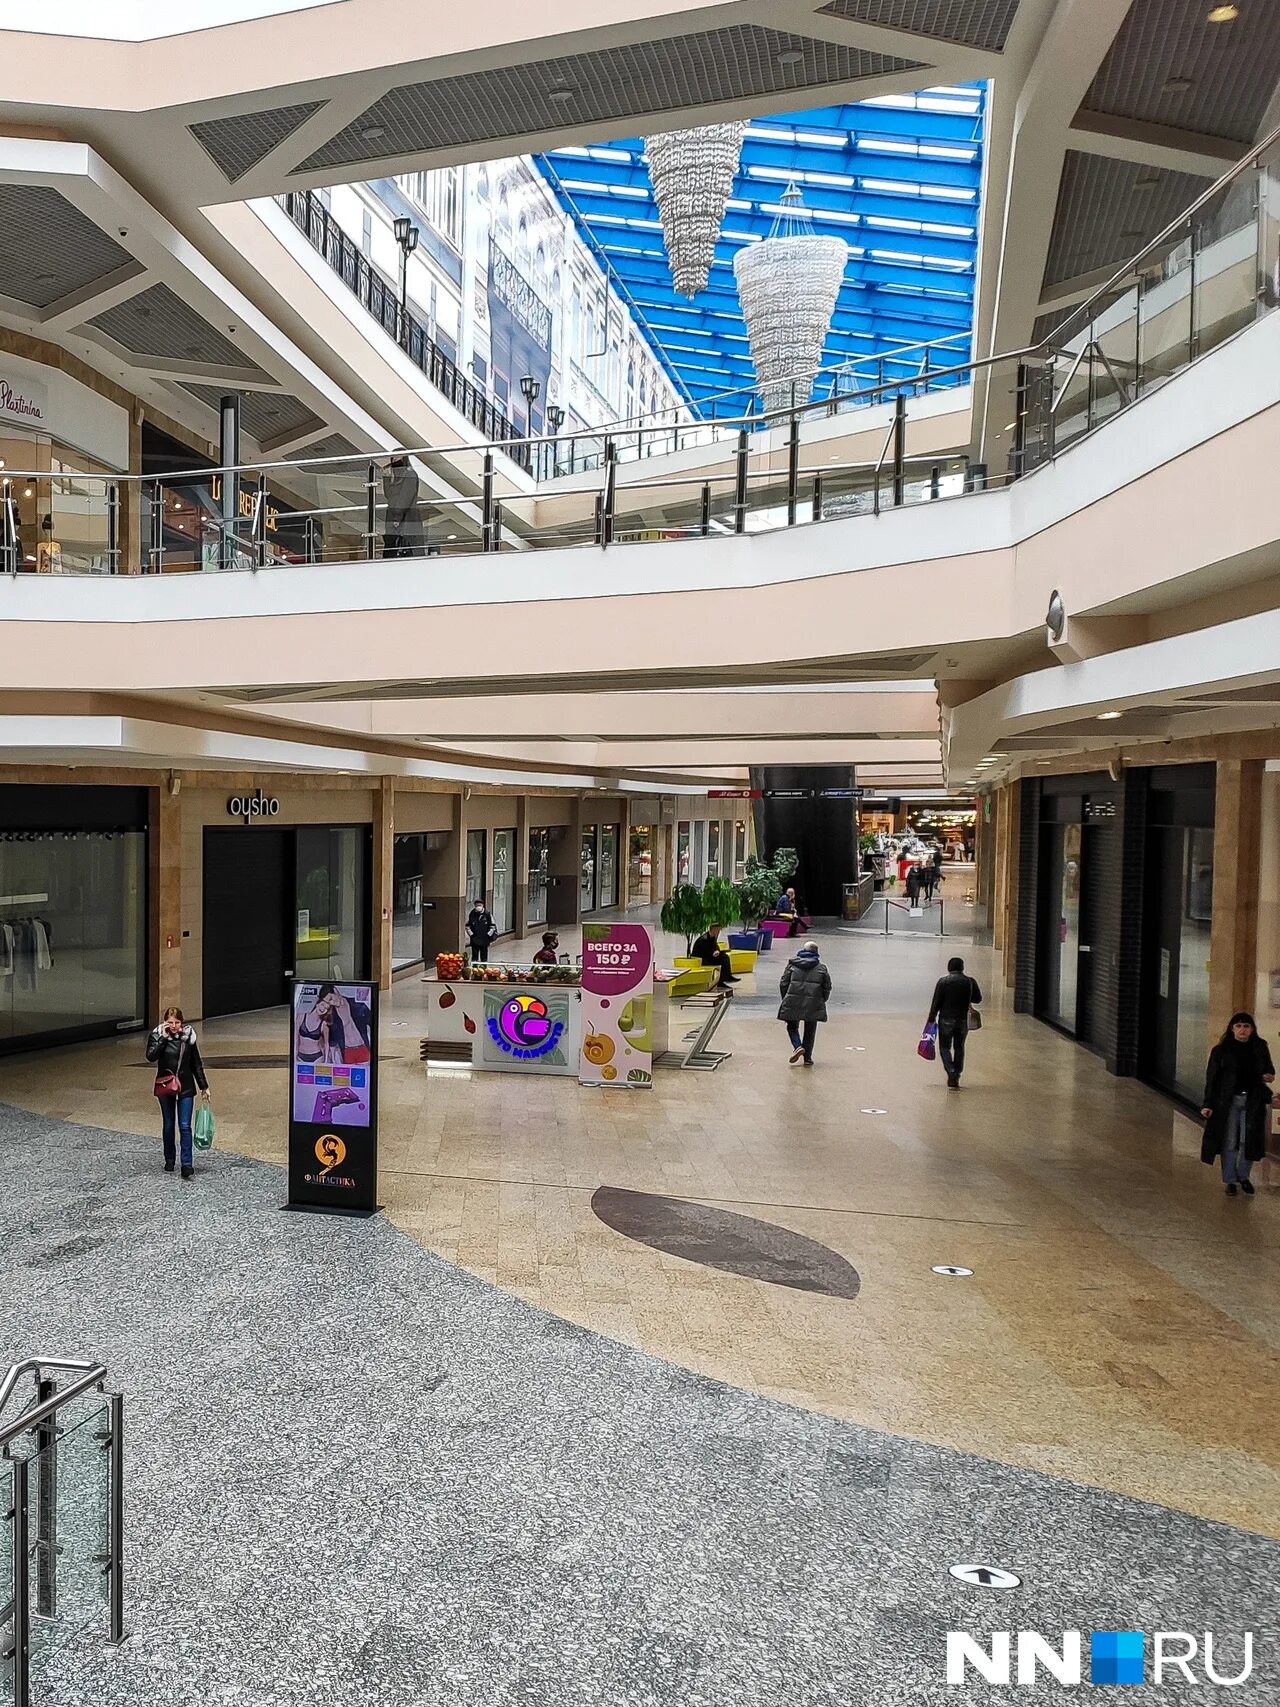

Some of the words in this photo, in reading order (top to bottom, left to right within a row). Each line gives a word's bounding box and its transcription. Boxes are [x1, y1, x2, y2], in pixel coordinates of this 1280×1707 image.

[230, 788, 280, 825] oysho
[587, 942, 622, 952] ВСЕГО
[623, 943, 638, 952] ЗА
[596, 953, 620, 965] 150
